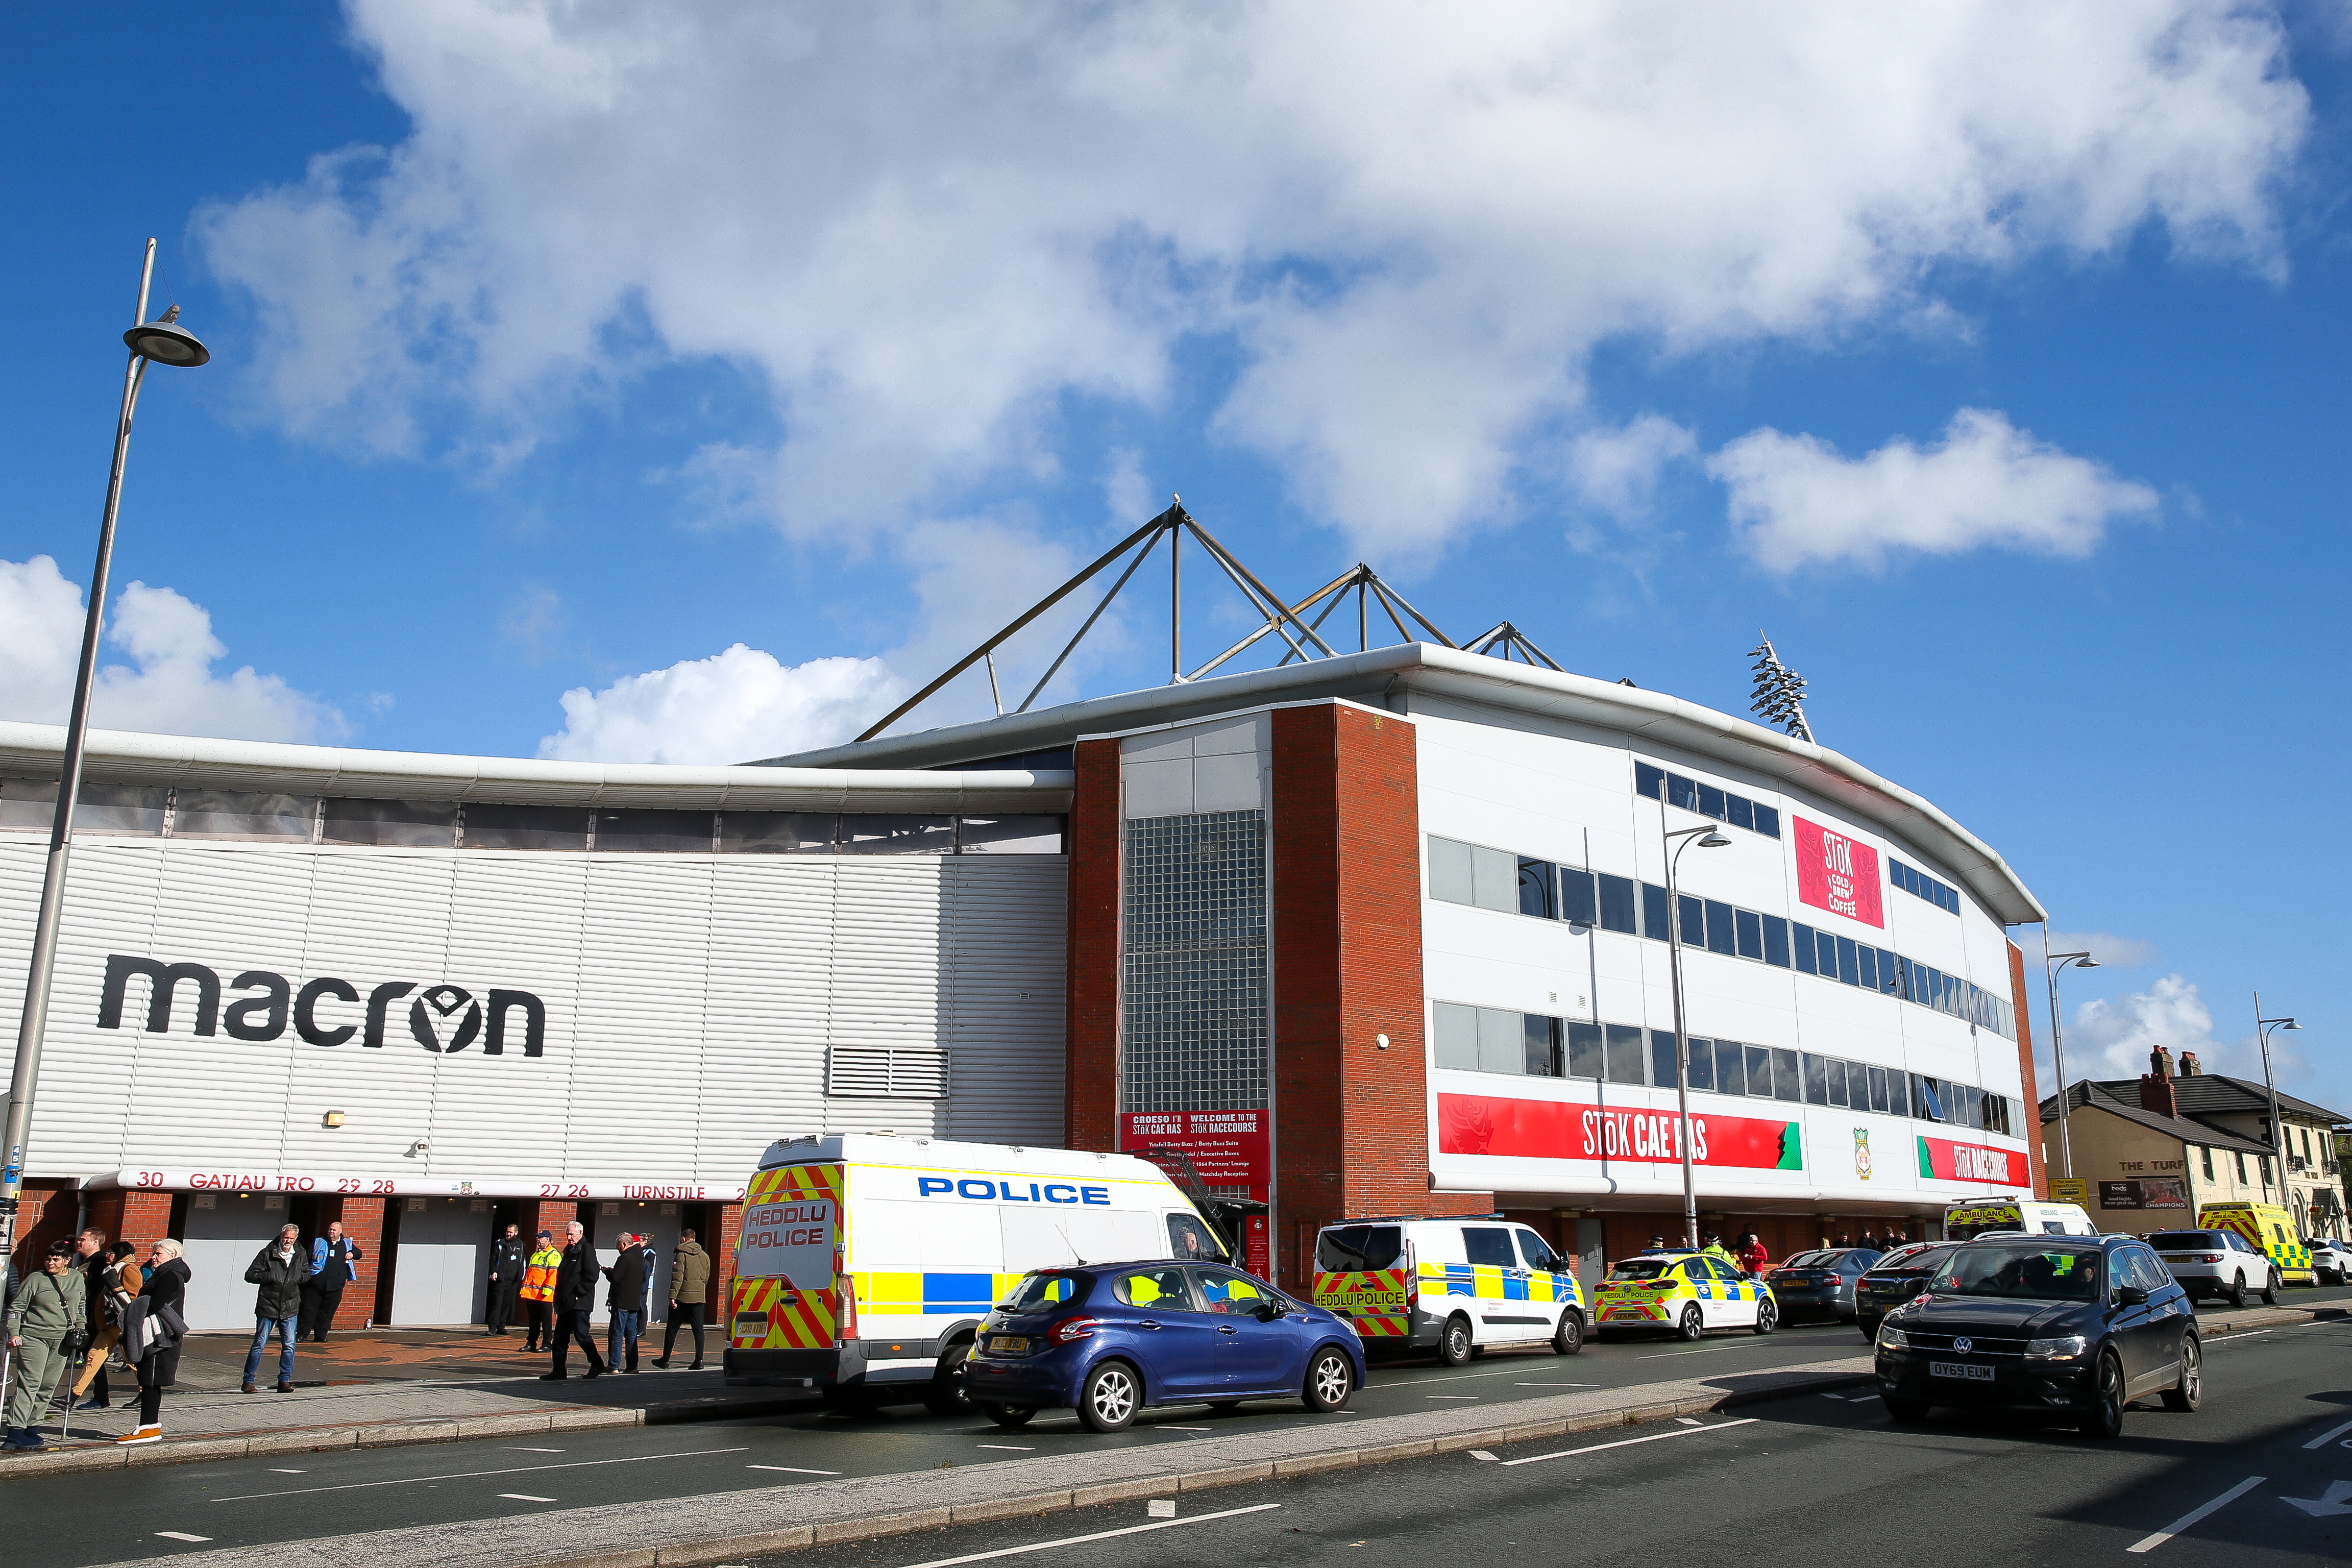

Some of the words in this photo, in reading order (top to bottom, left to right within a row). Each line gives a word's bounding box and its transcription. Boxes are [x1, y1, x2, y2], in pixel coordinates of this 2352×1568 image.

[1831, 873, 1849, 889] COLD
[1832, 886, 1850, 900] BREW
[1828, 892, 1857, 917] COFFEE
[96, 954, 546, 1057] macron
[1133, 1115, 1169, 1123] CROESO
[1190, 1114, 1236, 1122] WELCOME
[1151, 1124, 1165, 1134] CAE
[1167, 1123, 1182, 1134] RAS
[1209, 1122, 1257, 1133] RACECOURSE
[1633, 1113, 1671, 1158] CAE
[1971, 1147, 2010, 1182] RACECOURSE
[2119, 1161, 2144, 1171] THE
[2150, 1160, 2184, 1170] TURF
[137, 1171, 163, 1187] 30
[189, 1173, 266, 1190] GATIAU
[276, 1175, 314, 1191] TRO
[337, 1178, 360, 1193] 29
[372, 1180, 394, 1194] 28
[540, 1184, 560, 1197] 27
[568, 1184, 590, 1198] 26
[622, 1185, 705, 1200] TURNSTILE
[736, 1188, 746, 1200] 2
[918, 1177, 1111, 1205] POLICE
[748, 1205, 827, 1228] HEDDLU
[1958, 1210, 2009, 1219] AMBULANCE
[746, 1228, 825, 1250] POLICE
[1315, 1293, 1353, 1306] HEDDLU
[1357, 1292, 1404, 1305] POLICE
[1934, 1363, 1965, 1376] OY69
[1967, 1366, 1991, 1378] EUM
